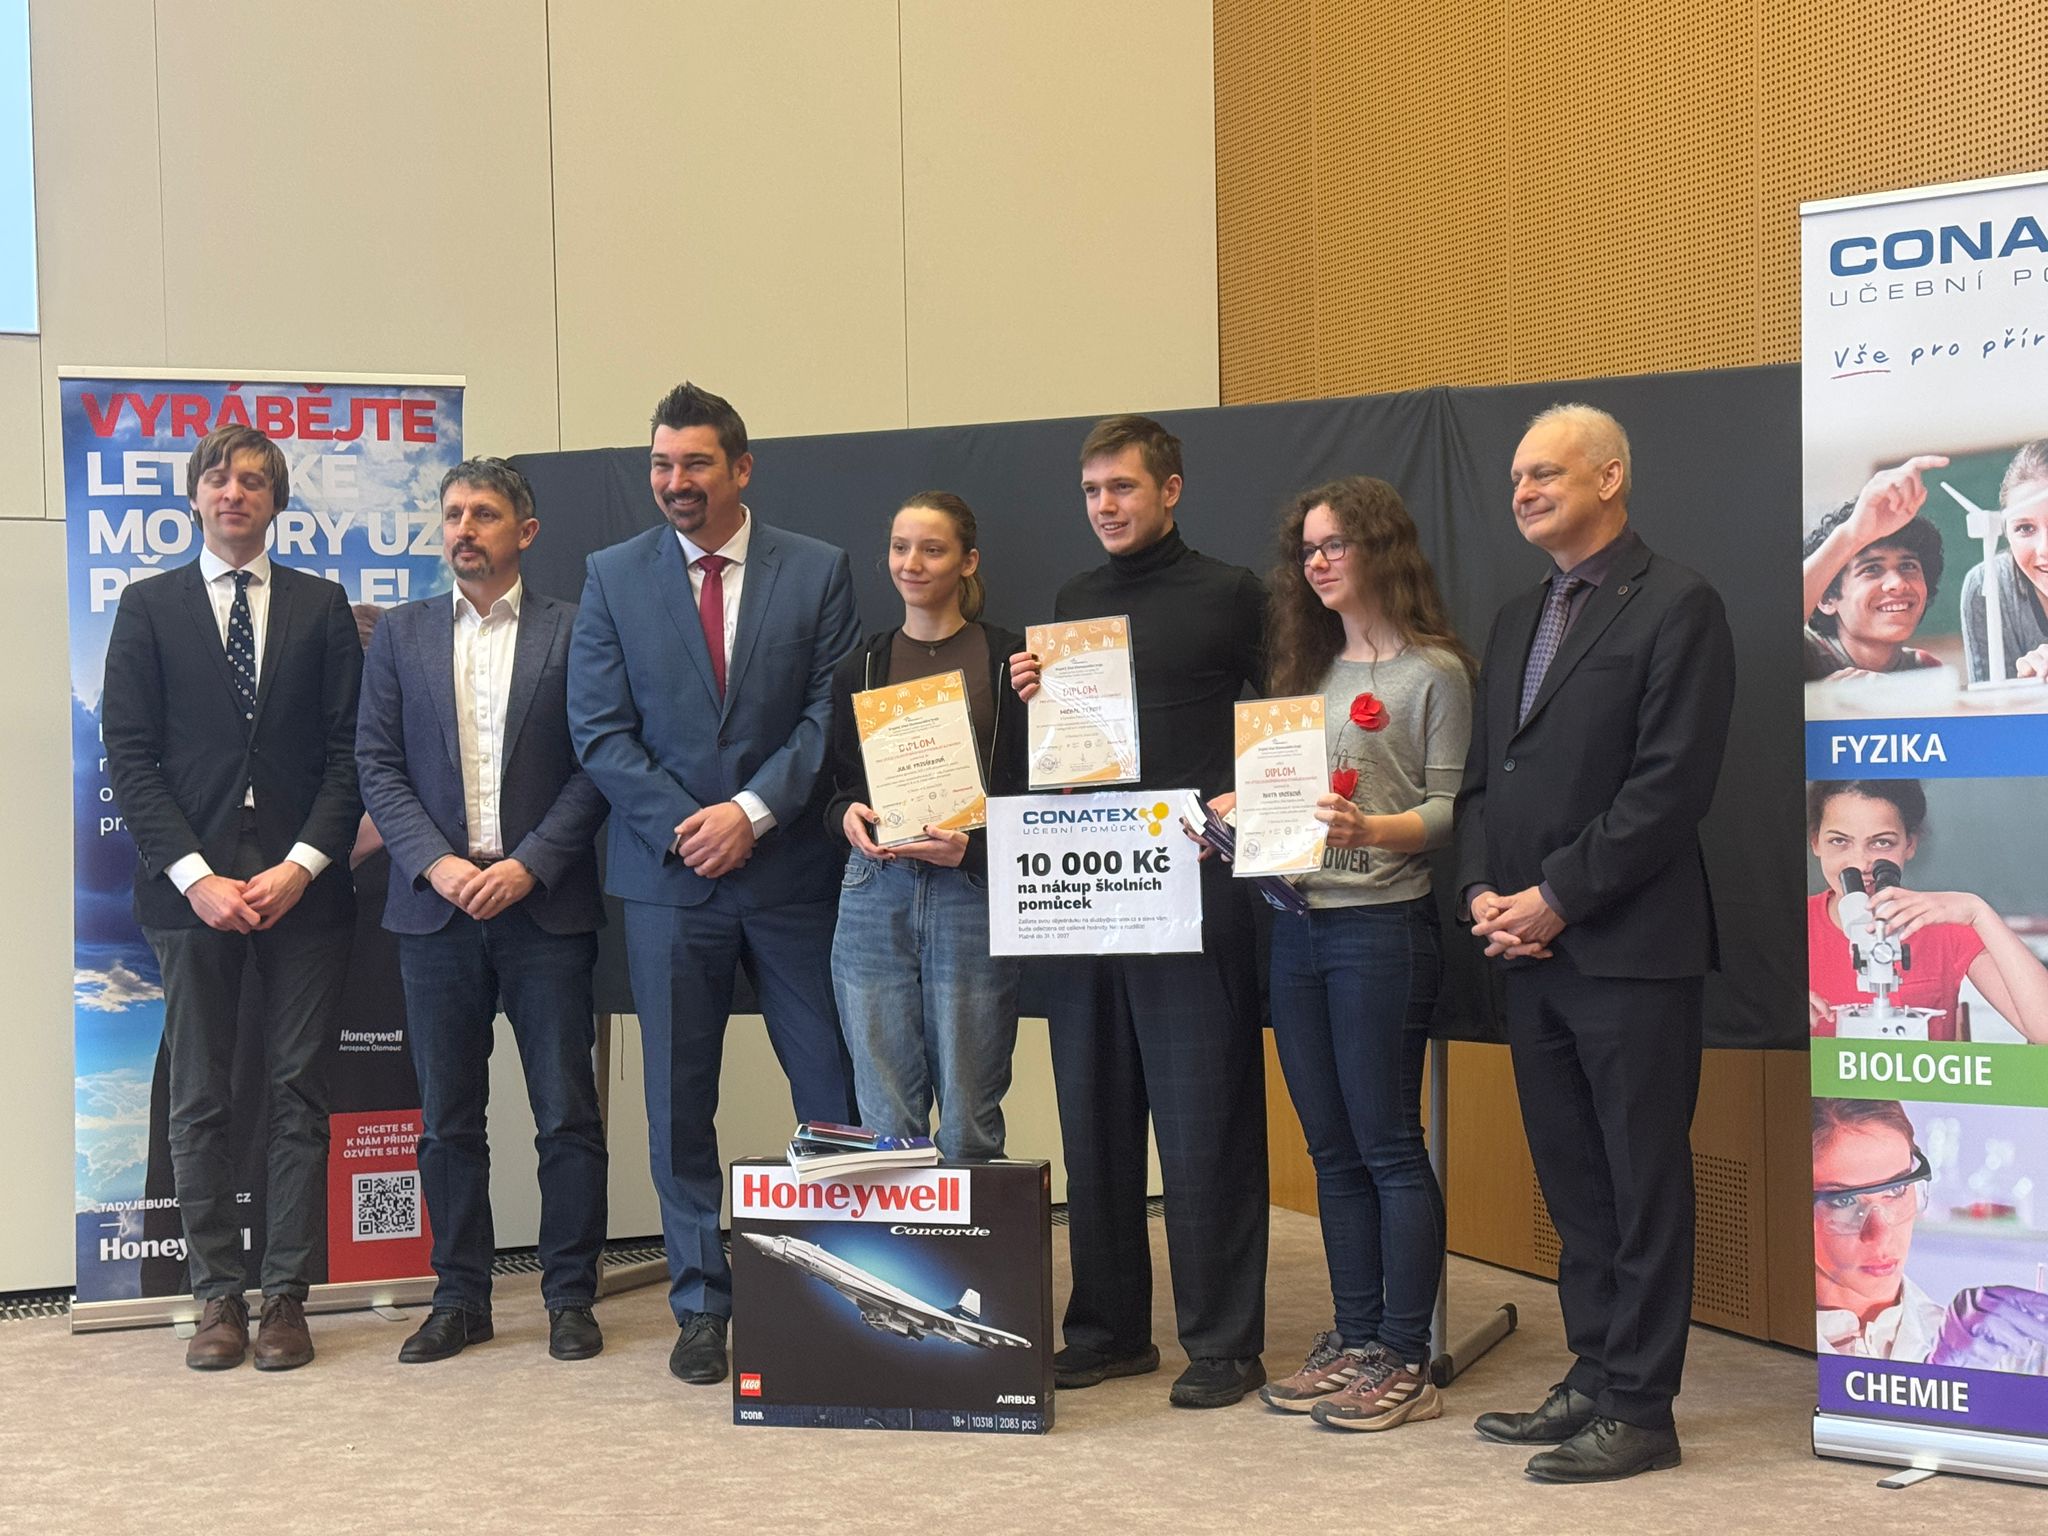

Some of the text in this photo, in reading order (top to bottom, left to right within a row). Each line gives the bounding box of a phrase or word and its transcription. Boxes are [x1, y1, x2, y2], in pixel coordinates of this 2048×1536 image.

[1830, 269, 1983, 307] UČEBNÍ
[1834, 342, 1890, 369] Vše
[1911, 343, 1960, 366] pro
[81, 383, 437, 443] VYRÁBĚJTE
[87, 442, 358, 497] LETKÉ
[1063, 684, 1098, 697] DIPLOM
[898, 736, 936, 753] DIPLOM
[1831, 733, 1947, 764] FYZIKA
[1264, 766, 1297, 778] DIPLOM
[1022, 807, 1140, 825] CONATEX
[1023, 823, 1145, 835] UČEBNÍ POMŮCKY
[1016, 846, 1171, 877] 10 000 Kč
[1323, 846, 1370, 874] OWER
[1017, 877, 1162, 895] na nákup školních
[1018, 895, 1093, 914] pomůcek
[340, 1029, 403, 1044] Honeywell
[339, 1044, 370, 1052] Aerospace
[1838, 1050, 1992, 1086] BIOLOGIE
[357, 1123, 414, 1134] CHCETE SE
[346, 1138, 354, 1146] K
[356, 1134, 381, 1146] NÁM
[343, 1143, 417, 1159] OZVĚTE SE NÁ
[743, 1174, 960, 1218] Honeywell
[890, 1225, 991, 1237] Concorde
[741, 1379, 761, 1390] LEGO
[1845, 1370, 1969, 1413] CHEMIE
[996, 1395, 1036, 1405] AIRBUS
[952, 1415, 1037, 1431] 18+ 10318 2083 pcs
